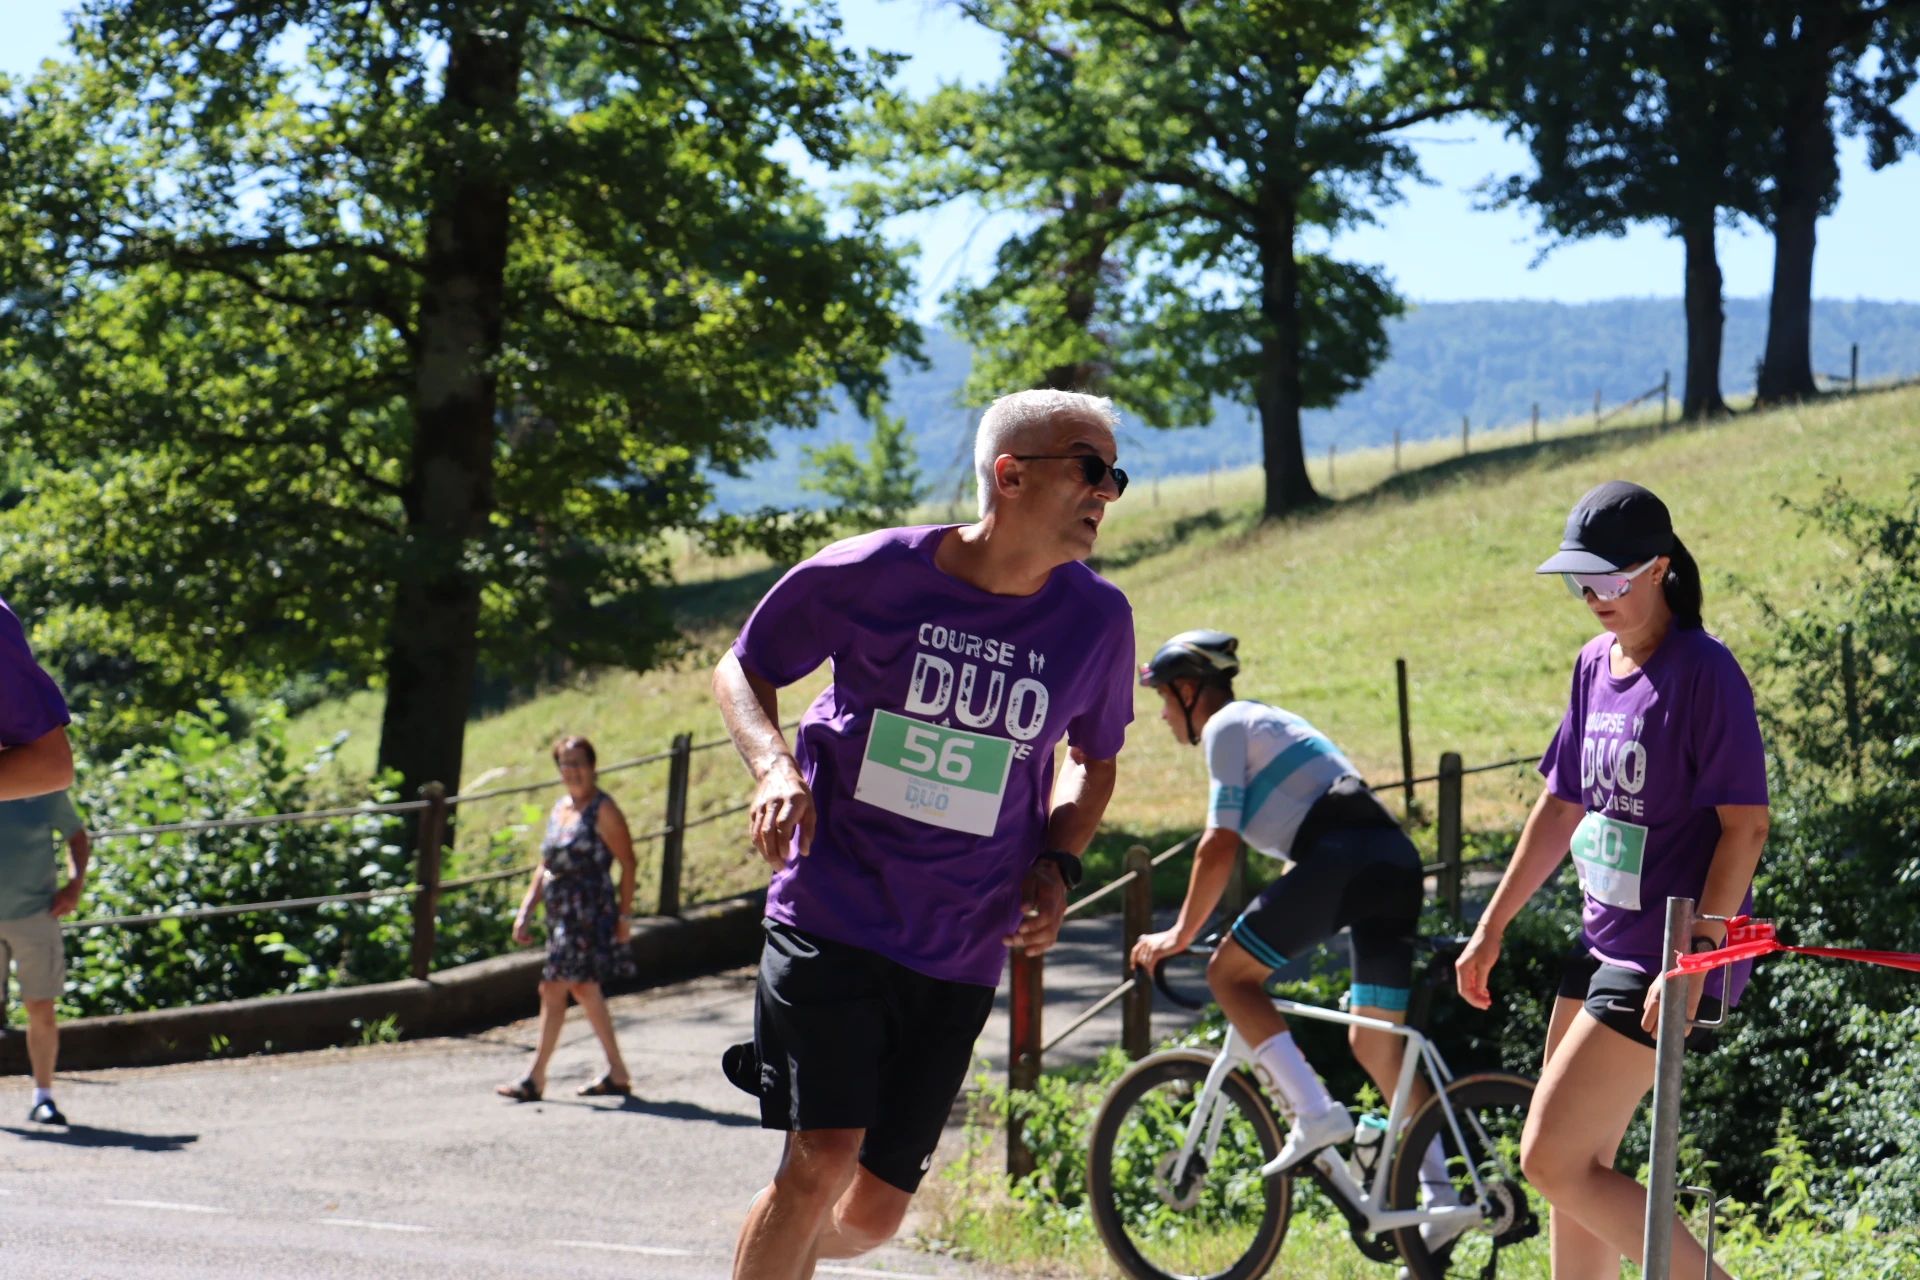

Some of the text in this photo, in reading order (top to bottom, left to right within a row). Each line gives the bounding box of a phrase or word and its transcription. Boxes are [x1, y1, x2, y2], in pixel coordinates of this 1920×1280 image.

[918, 622, 1016, 667] COURSE
[904, 652, 1049, 741] DUO
[900, 725, 975, 782] 56
[1581, 737, 1647, 795] DUO
[905, 784, 949, 811] DUO
[1583, 820, 1622, 864] 30
